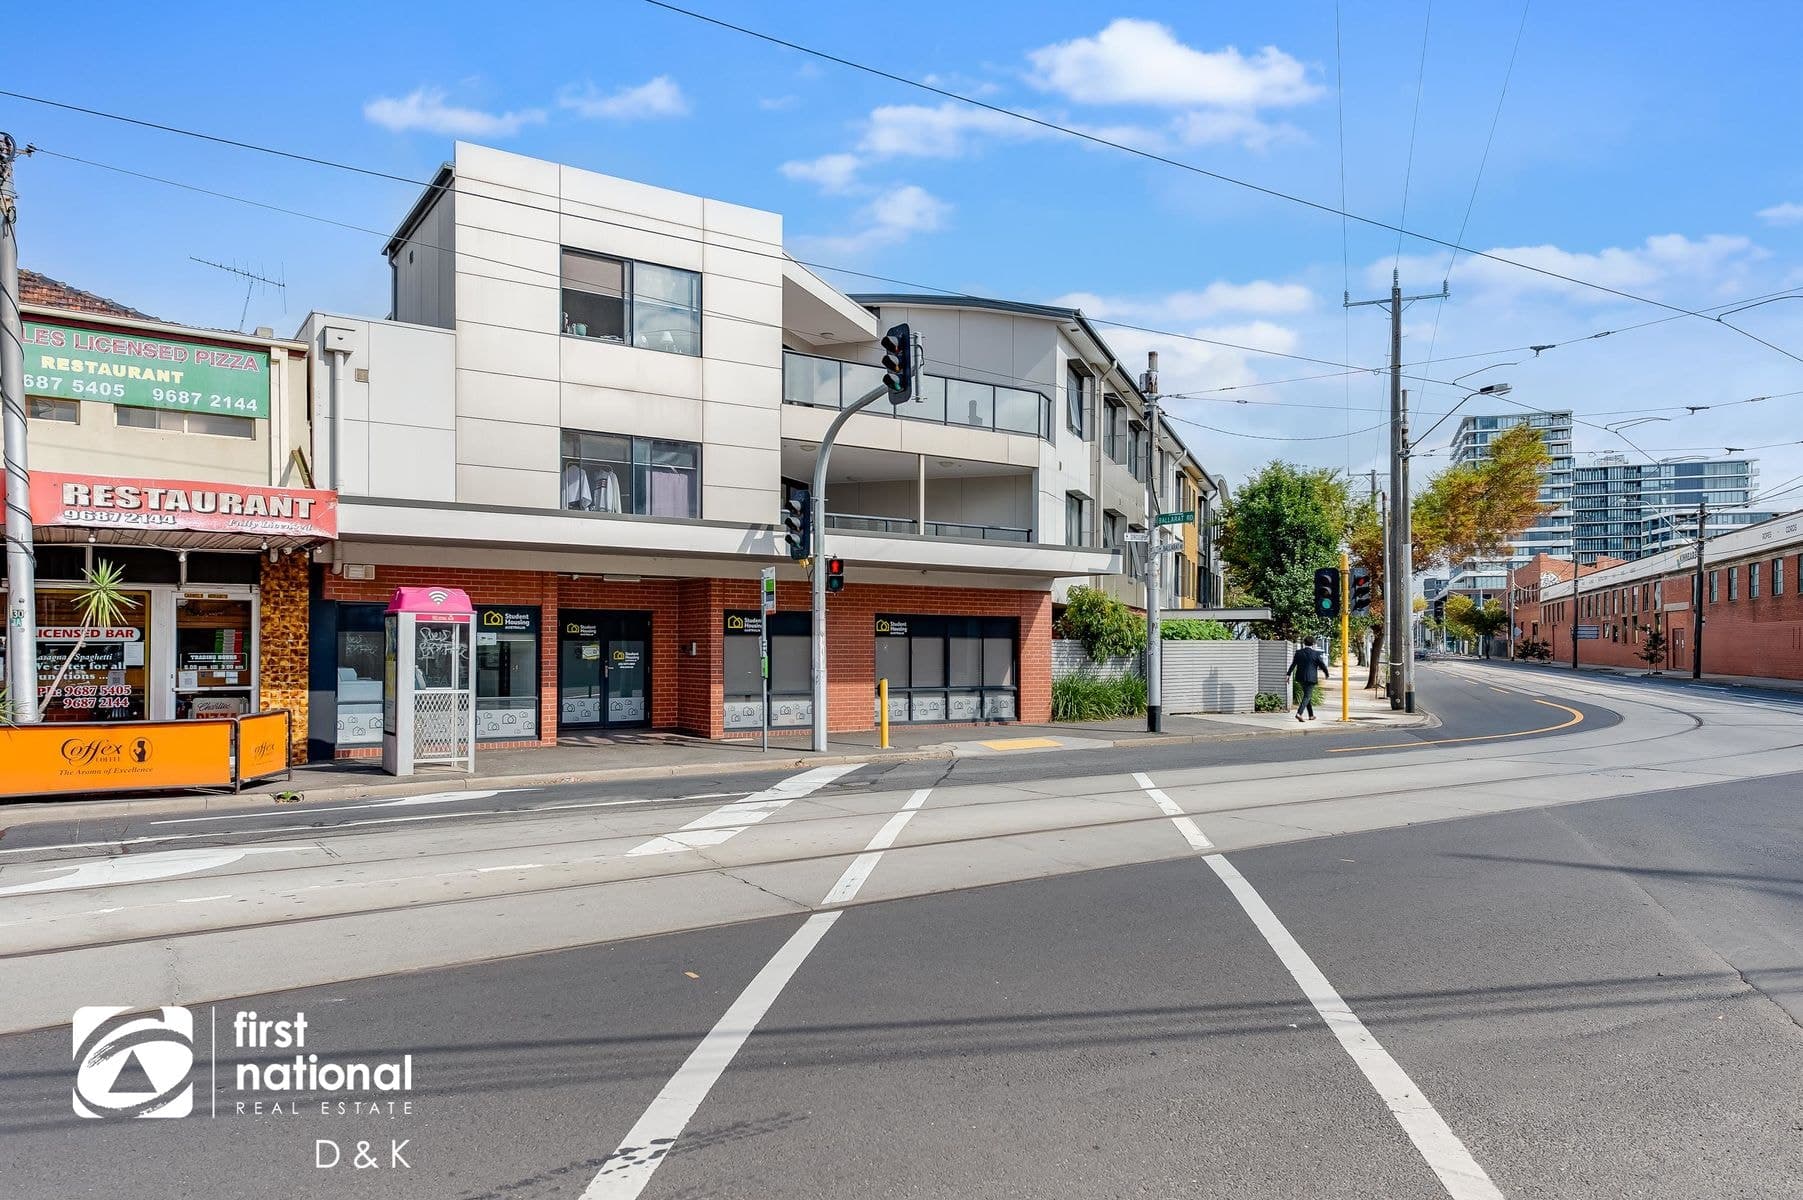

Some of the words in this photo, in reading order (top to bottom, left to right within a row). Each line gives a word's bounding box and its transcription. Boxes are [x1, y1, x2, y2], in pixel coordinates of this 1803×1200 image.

[20, 326, 66, 348] LES
[73, 332, 189, 363] LICENSED
[195, 349, 259, 372] PIZZA
[41, 355, 184, 384] RESTAURANT
[23, 374, 64, 391] 687
[72, 379, 125, 397] 5405
[152, 388, 202, 405] 9687
[210, 394, 258, 412] 2144
[62, 482, 316, 519] RESTAURANT
[64, 510, 120, 522] 9687
[125, 513, 176, 525] 2144
[228, 519, 259, 529] Fully
[505, 619, 530, 627] Housing
[36, 629, 101, 638] ICENSED
[105, 629, 135, 638] BAR
[36, 654, 67, 662] asagna
[74, 653, 113, 662] Spaghetti
[53, 663, 87, 671] cter
[89, 662, 108, 671] for
[110, 662, 127, 670] all
[38, 671, 96, 681] untions
[64, 685, 97, 697] 9687
[100, 685, 132, 696] 5405
[63, 697, 97, 709] 9687
[99, 697, 130, 708] 2144
[61, 738, 123, 767] Coffex
[76, 768, 102, 776] Aroma
[104, 768, 112, 776] of
